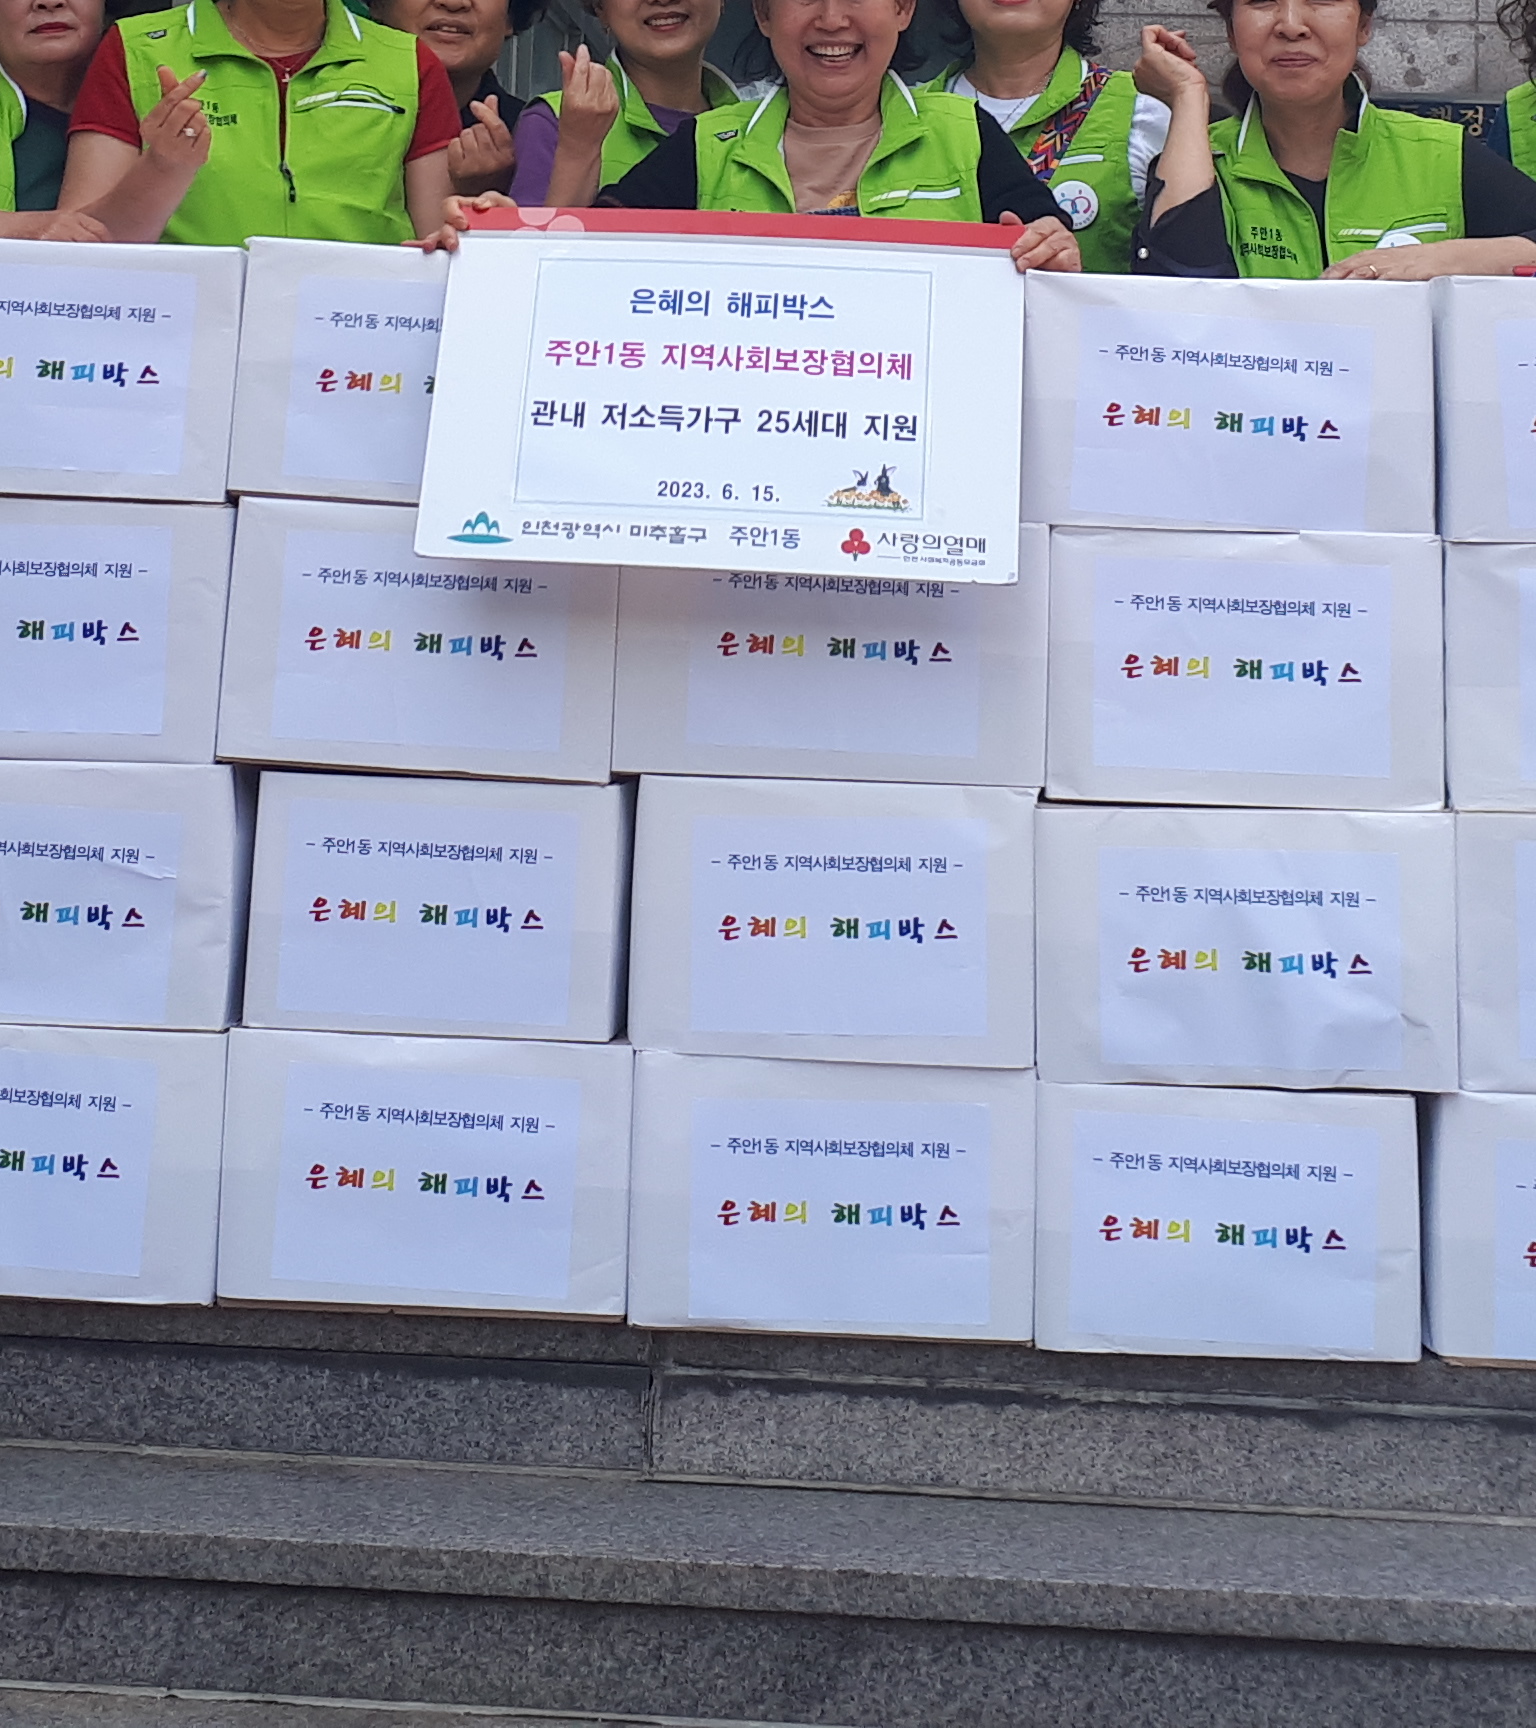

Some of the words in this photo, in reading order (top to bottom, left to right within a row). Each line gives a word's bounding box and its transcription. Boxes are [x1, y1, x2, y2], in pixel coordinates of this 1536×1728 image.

[1250, 226, 1283, 242] 주안1동
[629, 286, 712, 318] 은혜의
[727, 289, 836, 321] 해피박스
[544, 338, 647, 370] 주안1동
[662, 340, 914, 381] 지역사회보장협의체
[1114, 344, 1167, 364] 주안1동
[1170, 349, 1298, 375] 지역사회보장협의체
[1303, 360, 1334, 377] 지원
[530, 399, 586, 430] 관내
[601, 401, 742, 436] 저소득가구
[756, 407, 849, 440] 25세대
[863, 410, 919, 443] 지원
[1102, 401, 1191, 430] 은혜의
[1213, 410, 1341, 443] 해피박스
[656, 479, 711, 501] 2023.
[721, 480, 741, 502] 6.
[751, 482, 781, 504] 15.
[520, 518, 622, 541] 인천광역시
[629, 522, 708, 546] 미추홀구
[728, 525, 802, 551] 주안1동
[103, 562, 133, 579] 지원
[15, 619, 140, 646] 해피박스
[319, 1102, 372, 1122] 주안1동
[376, 1106, 504, 1132] 지역사회보장협의체
[509, 1116, 540, 1134] 지원
[304, 1163, 395, 1192] 은혜의
[417, 1171, 546, 1204] 해피박스
